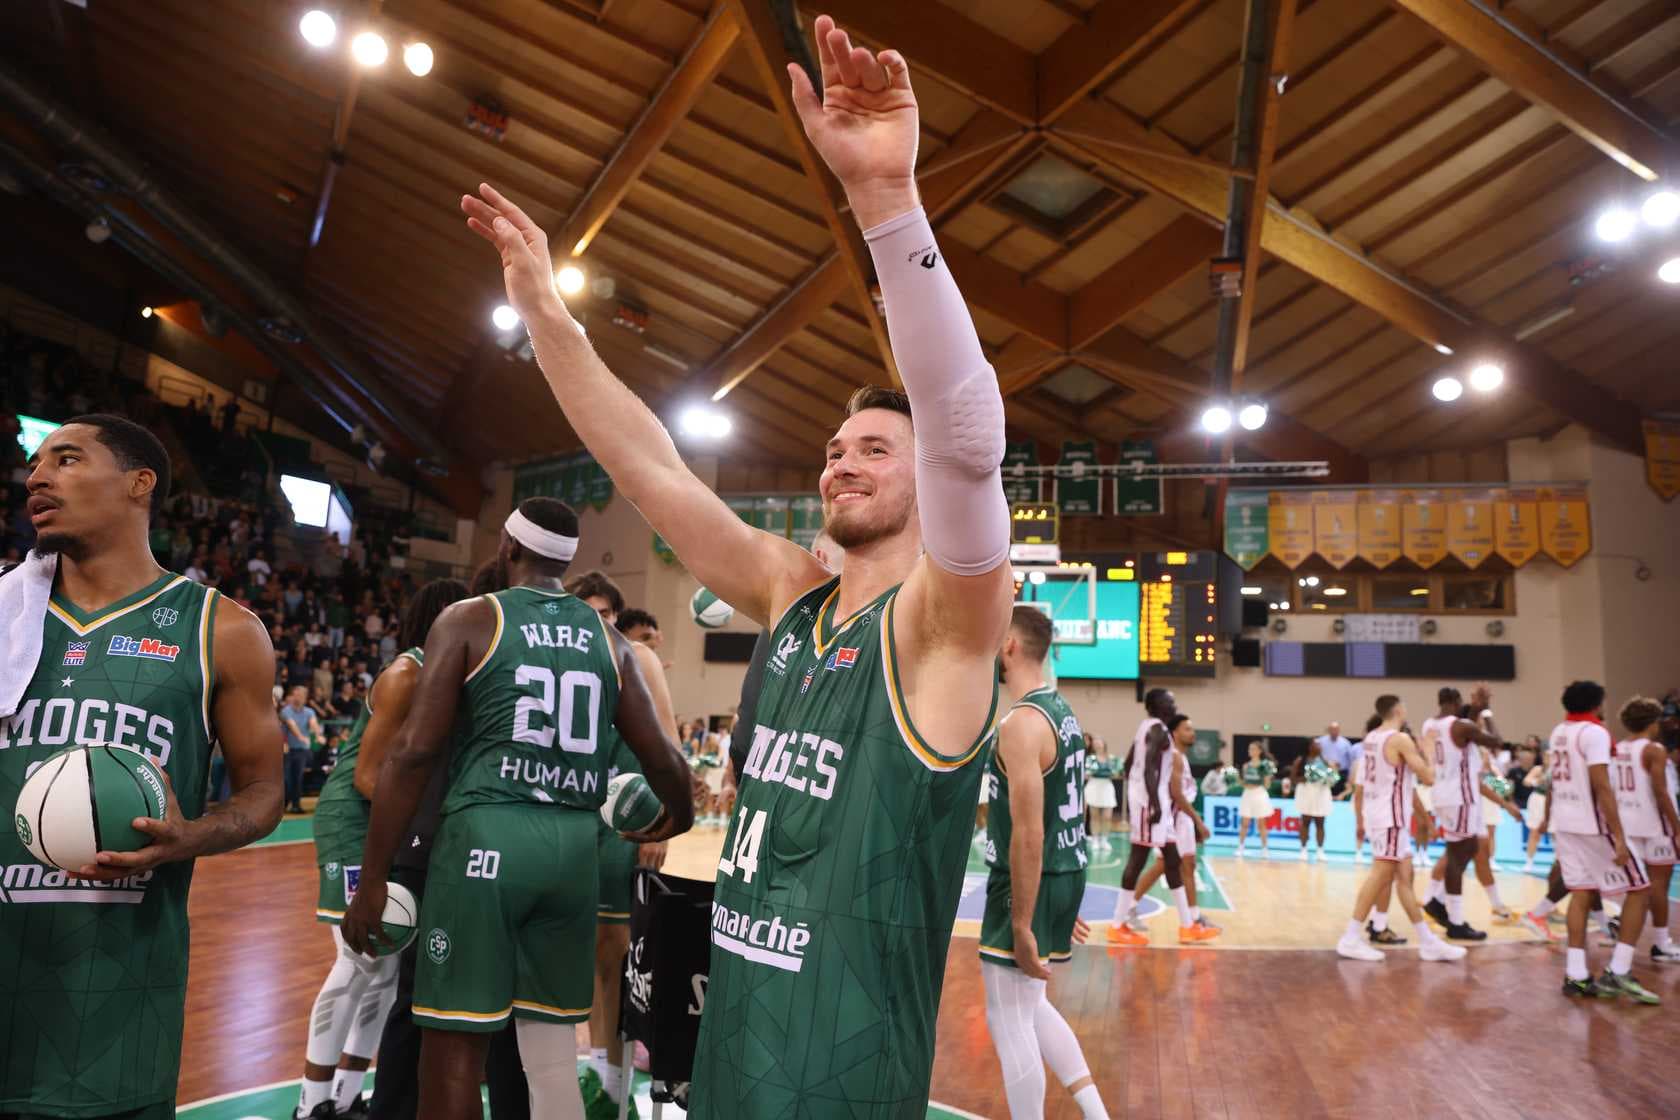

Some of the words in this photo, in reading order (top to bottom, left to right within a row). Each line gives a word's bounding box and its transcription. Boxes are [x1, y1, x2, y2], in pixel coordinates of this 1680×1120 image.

[109, 635, 181, 660] BigMat
[520, 623, 594, 654] WARE
[512, 664, 601, 755] 20
[500, 756, 599, 793] HUMAN
[719, 806, 768, 884] 14
[466, 849, 500, 879] 20
